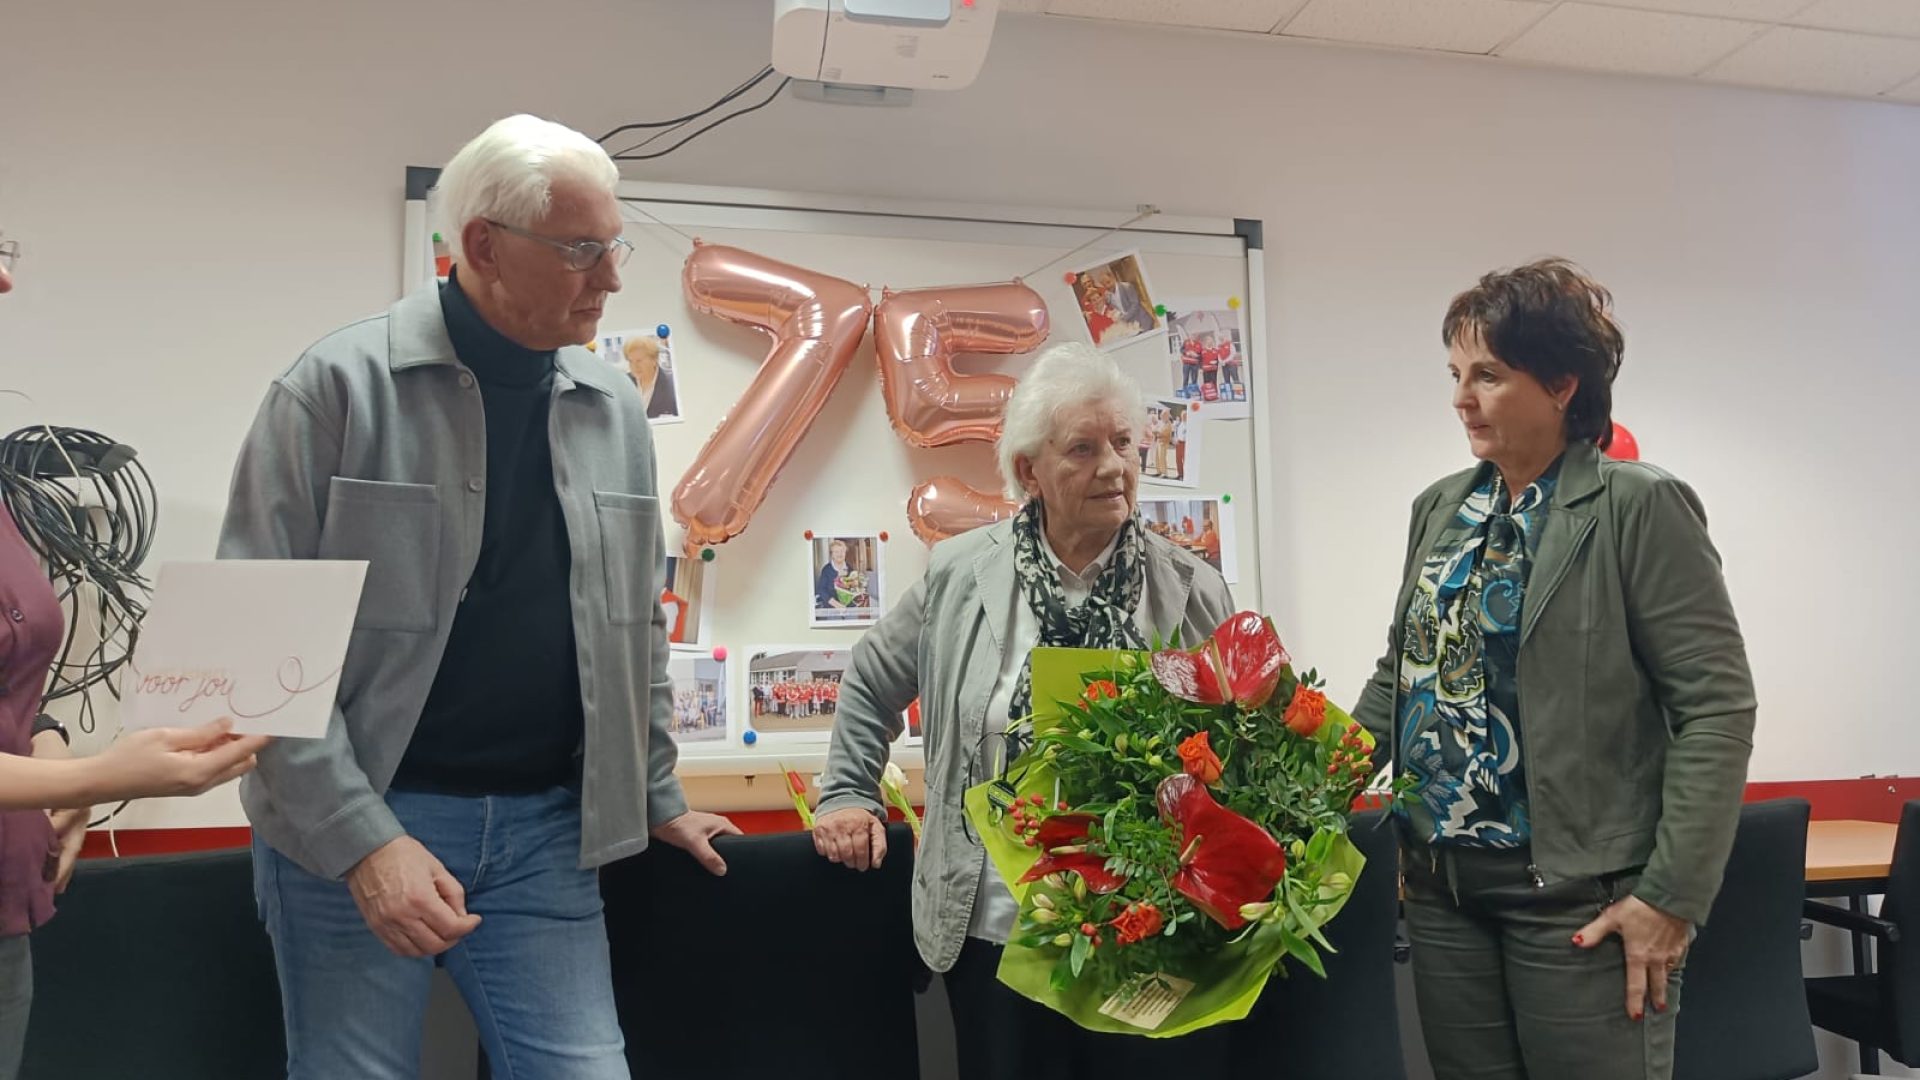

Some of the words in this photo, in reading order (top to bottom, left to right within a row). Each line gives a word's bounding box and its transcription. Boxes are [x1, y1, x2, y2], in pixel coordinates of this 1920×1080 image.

[672, 240, 1050, 550] 75
[135, 671, 190, 695] voor
[180, 676, 235, 713] jou
